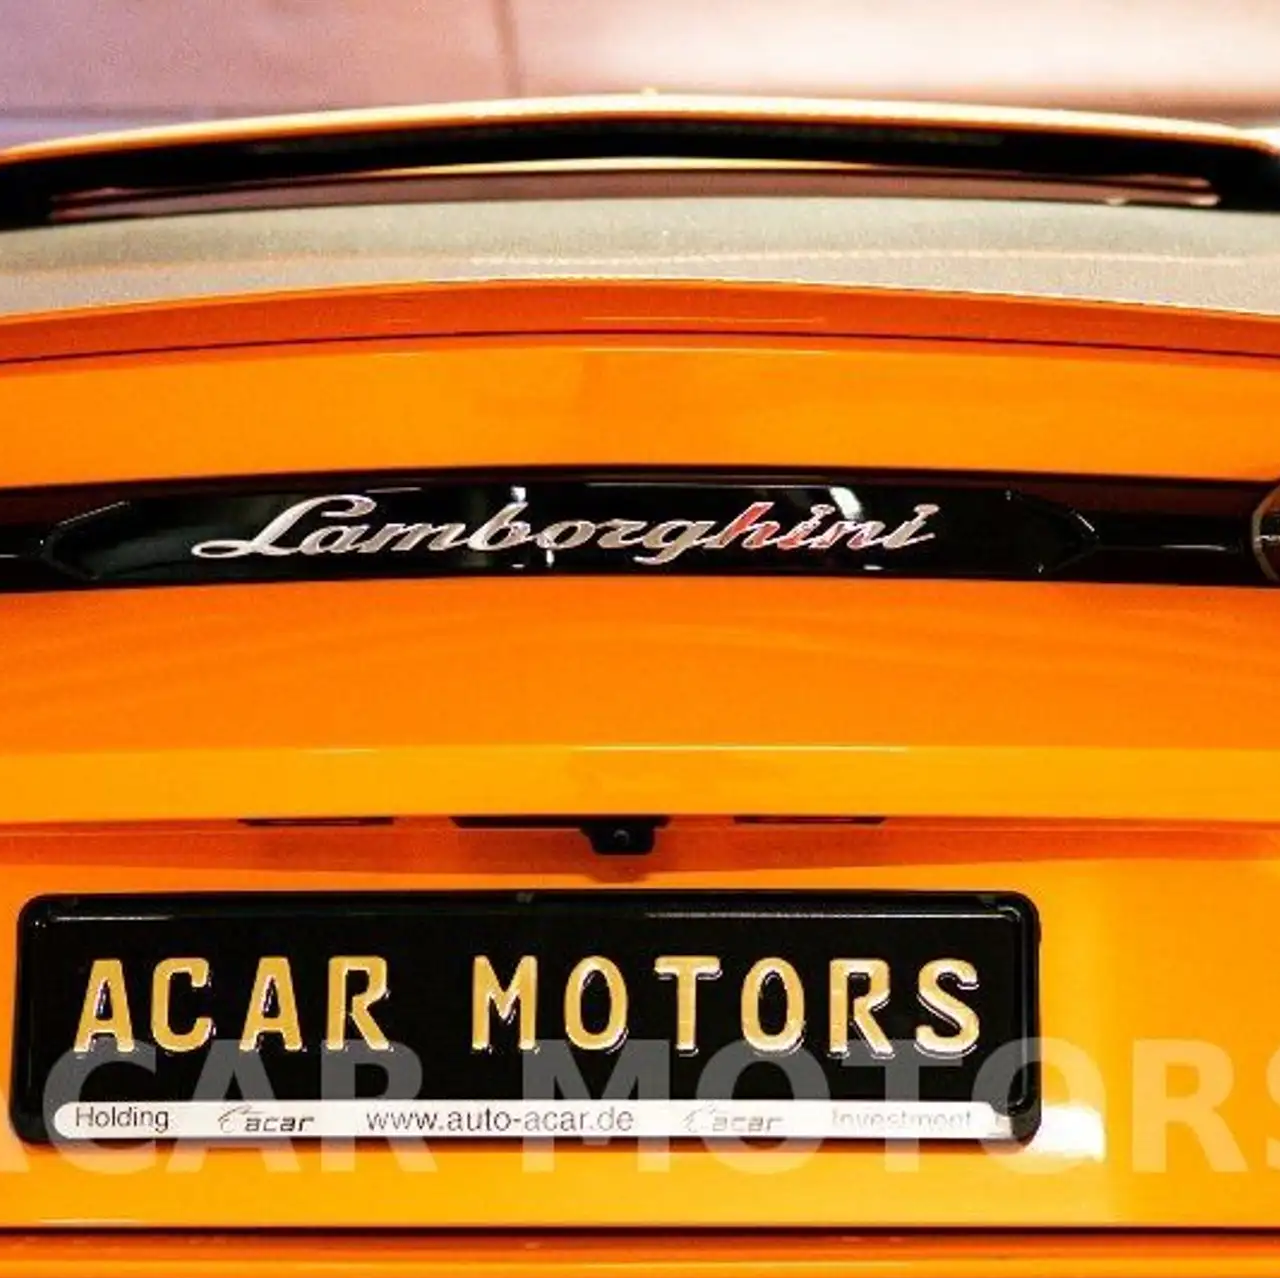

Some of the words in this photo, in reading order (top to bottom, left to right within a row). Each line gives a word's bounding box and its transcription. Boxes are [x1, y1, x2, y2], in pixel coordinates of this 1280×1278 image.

[192, 494, 942, 565] Lamborghini
[73, 955, 394, 1055] ACAR
[470, 954, 982, 1059] MOTORS
[74, 1105, 170, 1132] Holding
[365, 1106, 634, 1132] www.auto-acar.de
